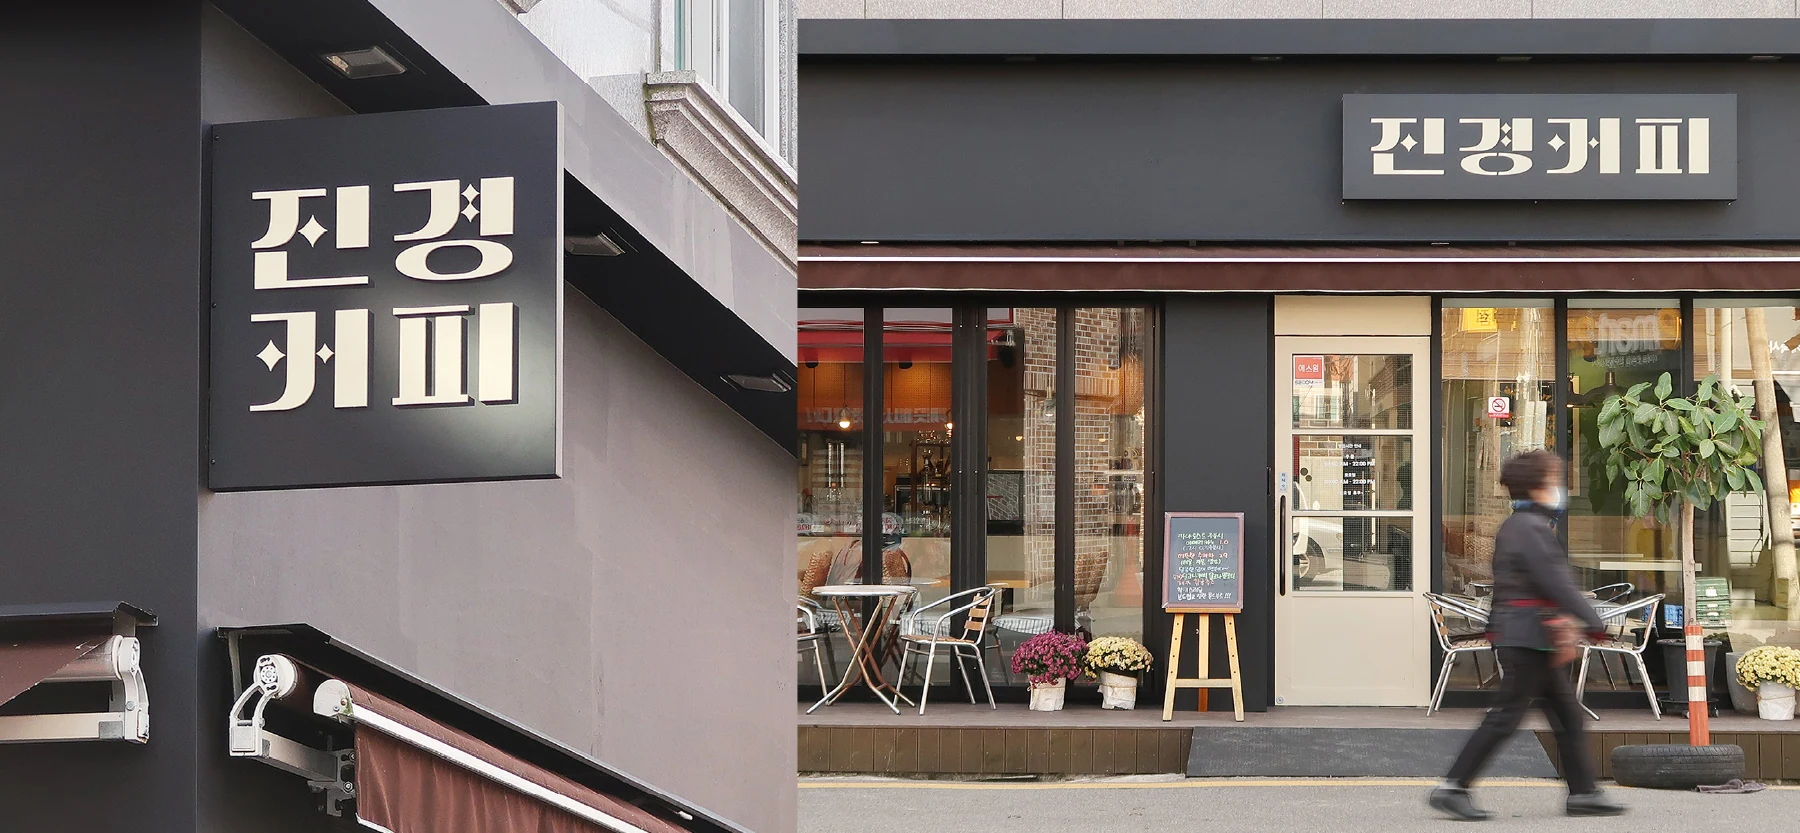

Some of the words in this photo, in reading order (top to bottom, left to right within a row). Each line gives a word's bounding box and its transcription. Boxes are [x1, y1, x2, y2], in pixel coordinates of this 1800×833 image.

[1370, 117, 1710, 176] 진경커피
[250, 176, 515, 291] 진경
[249, 302, 516, 412] 커피
[1298, 364, 1319, 373] 에스원
